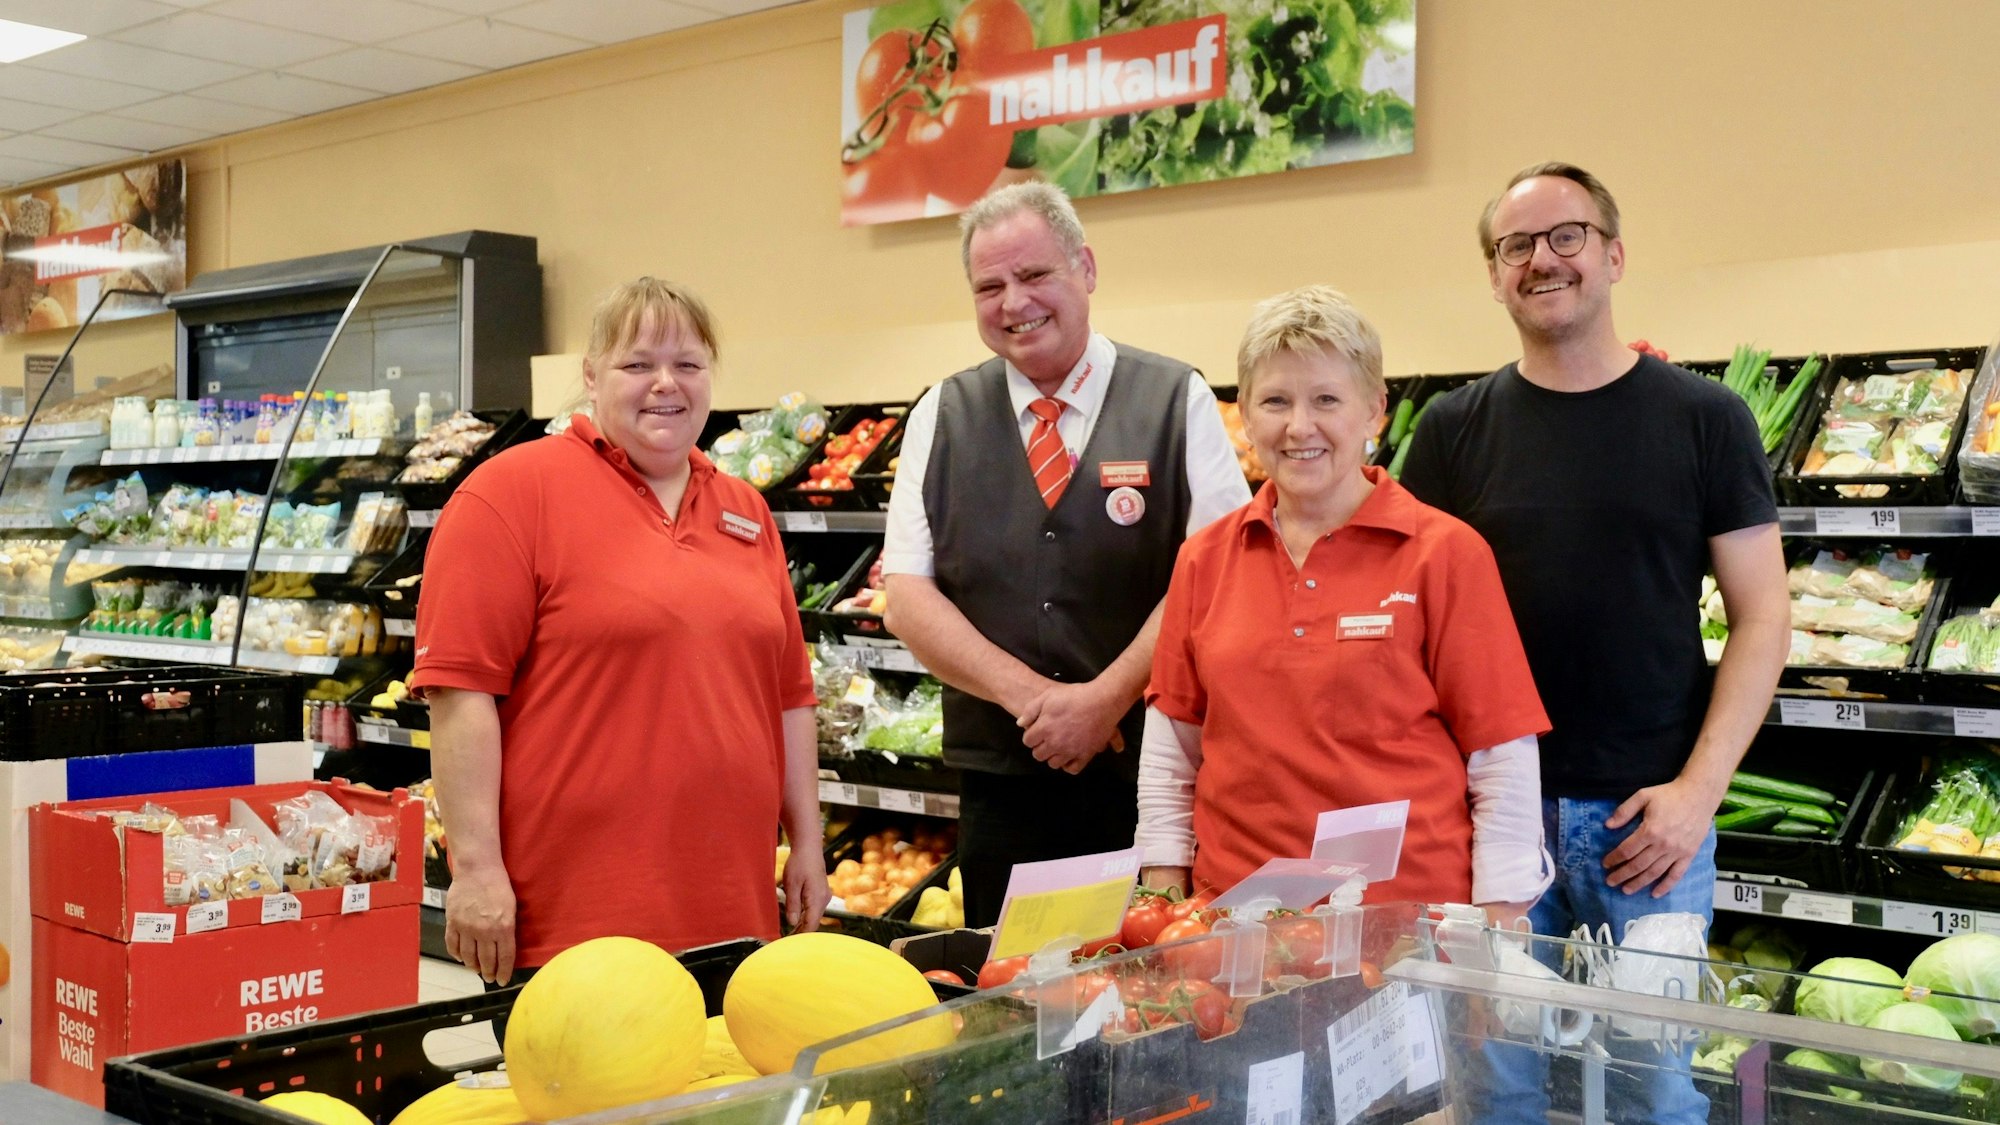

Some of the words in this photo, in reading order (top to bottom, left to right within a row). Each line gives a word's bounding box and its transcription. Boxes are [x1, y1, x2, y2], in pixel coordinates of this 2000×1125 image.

[989, 24, 1220, 126] nahkauf
[1871, 510, 1895, 527] 1.99
[725, 523, 757, 541] nahkauf
[1343, 625, 1386, 637] nahkauf
[1836, 703, 1860, 720] 2.79
[352, 893, 365, 903] 3.99
[1734, 885, 1758, 903] 0.75
[64, 902, 85, 919] REWE
[208, 909, 224, 921] 3.99
[282, 902, 297, 912] 3.99
[155, 923, 171, 934] 3.99
[1932, 911, 1970, 934] 1.39
[240, 968, 324, 1007] REWE
[56, 977, 98, 1017] REWE
[246, 1004, 319, 1034] Beste
[58, 1011, 95, 1046] Beste
[58, 1035, 94, 1072] Wahl
